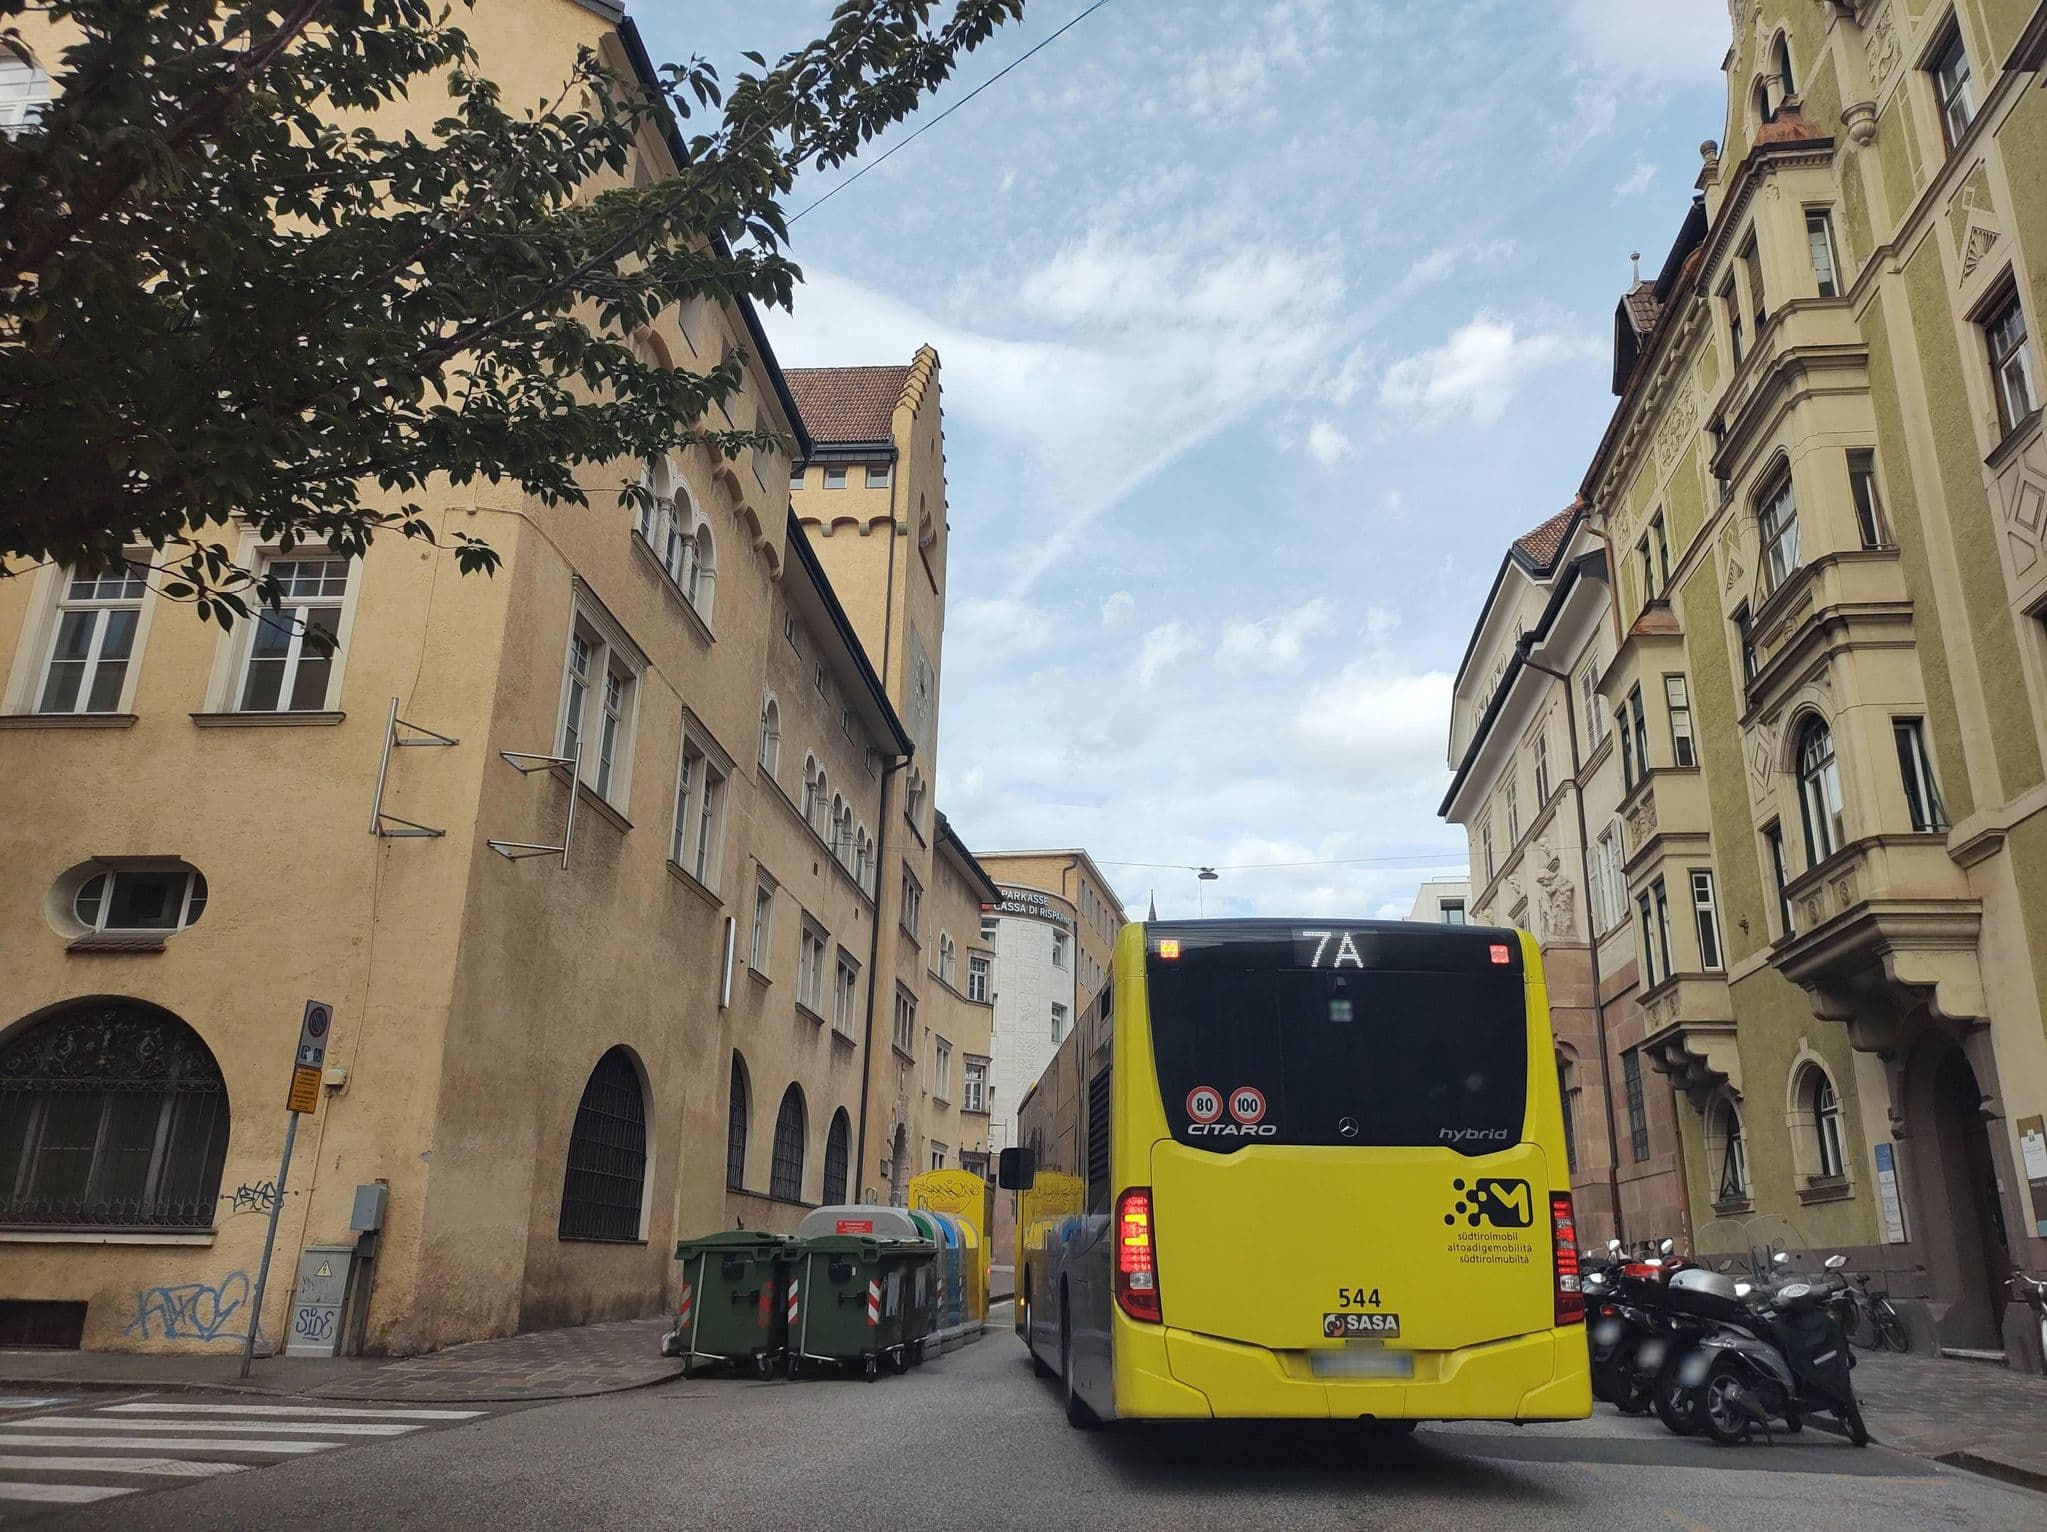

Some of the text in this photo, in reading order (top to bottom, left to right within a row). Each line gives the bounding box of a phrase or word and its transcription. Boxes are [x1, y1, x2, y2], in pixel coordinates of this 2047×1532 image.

[1001, 889, 1049, 905] PARKASSE
[994, 902, 1026, 913] CASSA
[1029, 905, 1038, 915] DI
[1302, 931, 1364, 968] 7A
[1196, 1097, 1213, 1112] 80
[1236, 1097, 1259, 1113] 100
[1187, 1123, 1277, 1136] CITARO
[1439, 1127, 1508, 1142] hybrid
[1457, 1231, 1518, 1241] südtirolmobil
[1338, 1288, 1382, 1308] 544
[1346, 1314, 1398, 1330] SASA
